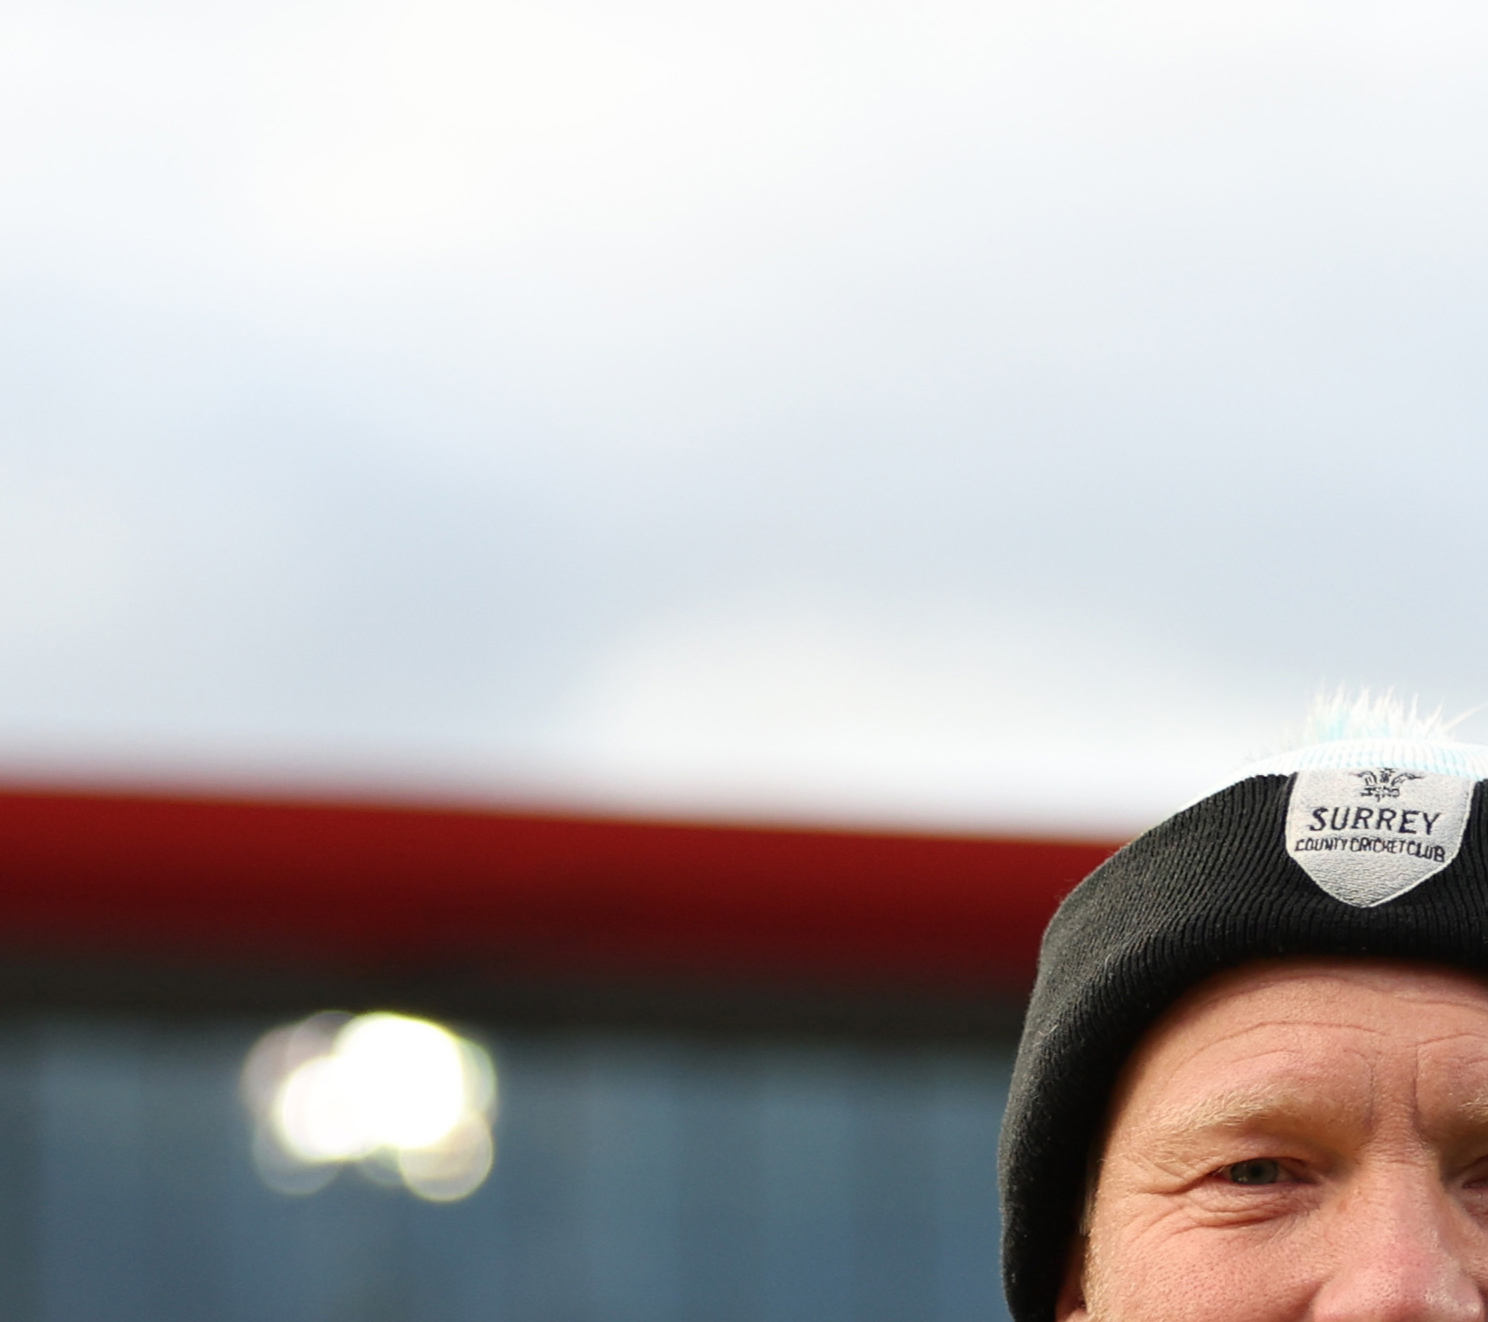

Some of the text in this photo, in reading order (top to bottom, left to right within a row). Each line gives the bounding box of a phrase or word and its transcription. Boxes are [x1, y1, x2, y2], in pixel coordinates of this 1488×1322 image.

[1309, 806, 1442, 835] SURREY
[1294, 837, 1446, 863] COUNTY CRICKET CLUB
